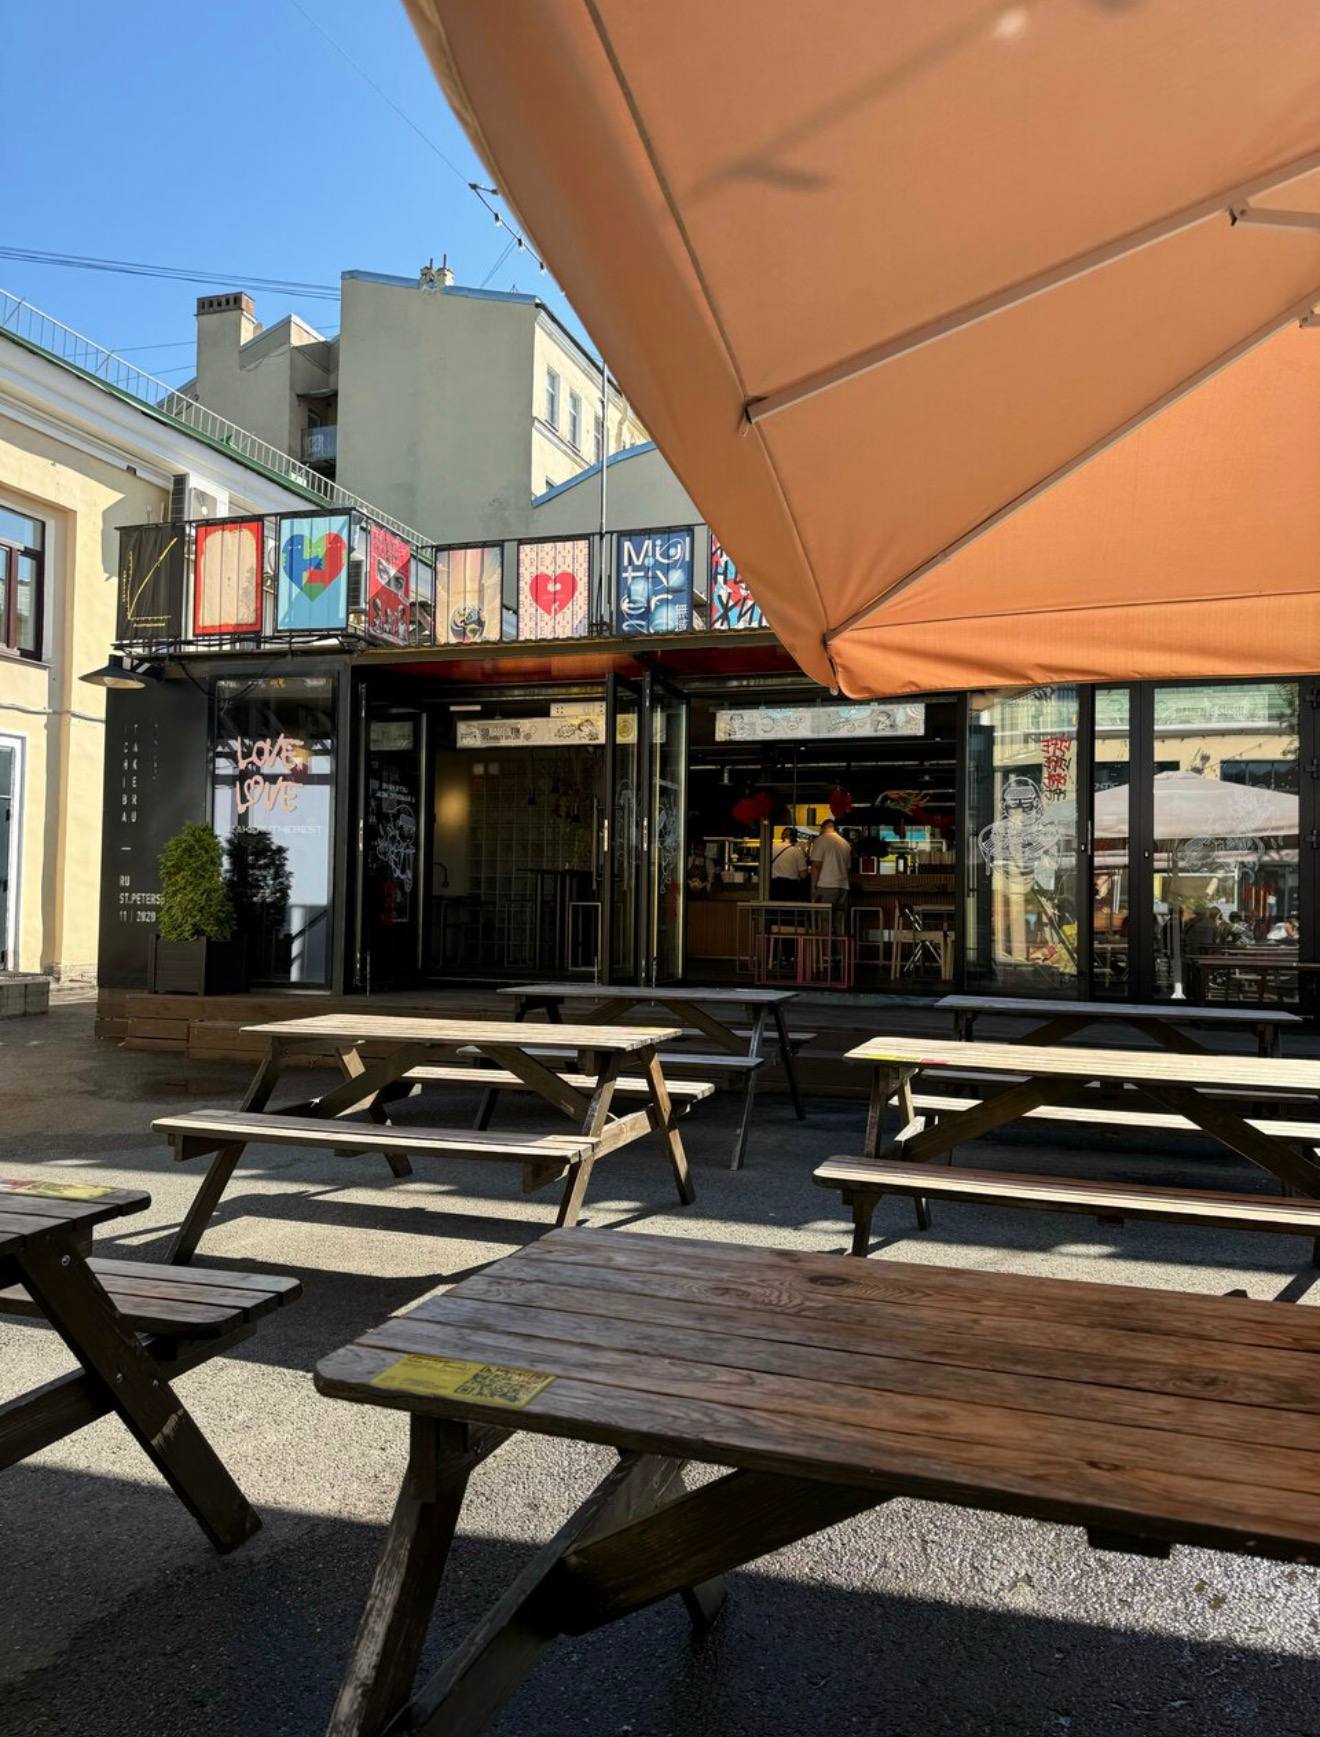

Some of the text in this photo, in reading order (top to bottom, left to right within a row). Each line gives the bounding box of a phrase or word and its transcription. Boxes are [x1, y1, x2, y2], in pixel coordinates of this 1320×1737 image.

[236, 733, 304, 773] LOVE
[236, 775, 303, 813] LOVE
[120, 875, 131, 886] RU
[136, 911, 156, 922] 2020
